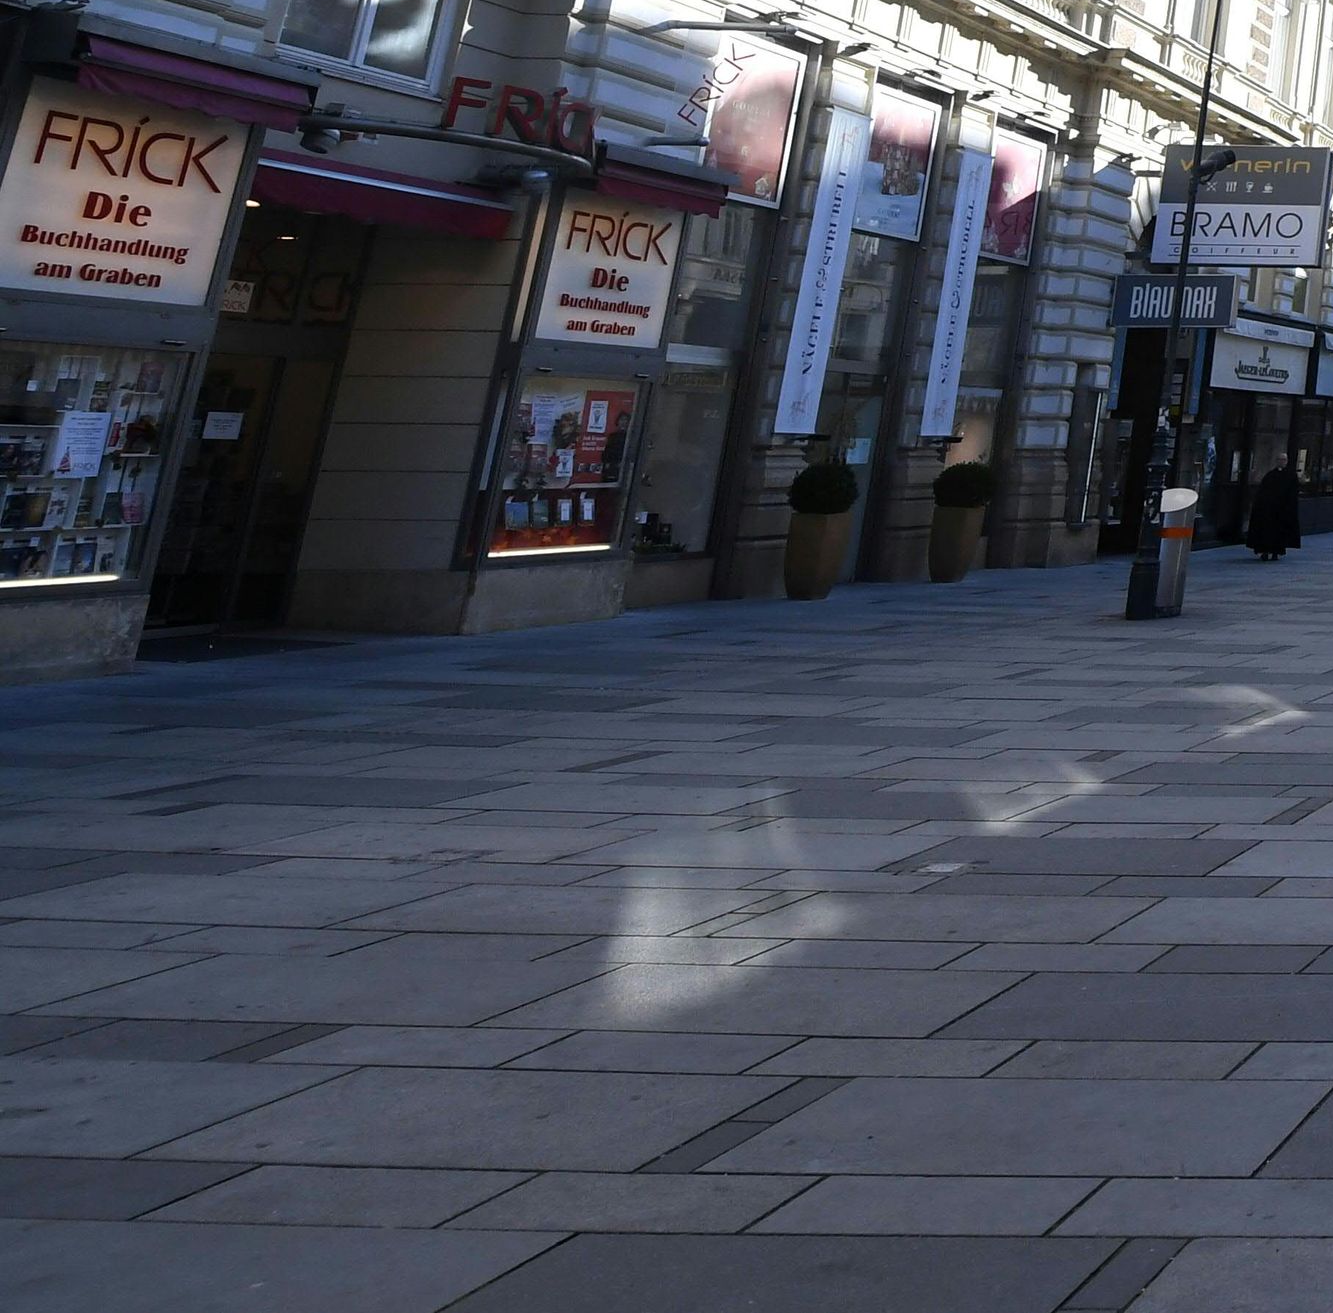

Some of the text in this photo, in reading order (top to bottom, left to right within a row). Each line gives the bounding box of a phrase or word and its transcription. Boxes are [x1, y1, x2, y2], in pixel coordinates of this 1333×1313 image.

[82, 191, 152, 227] Die
[1170, 211, 1303, 239] BRAMO
[20, 224, 190, 265] Buchhandlung
[1173, 247, 1295, 255] COIFFEUR
[33, 261, 162, 289] am Graben
[591, 267, 630, 292] Die
[560, 293, 651, 318] Buchhandlung
[566, 319, 636, 336] am Graben
